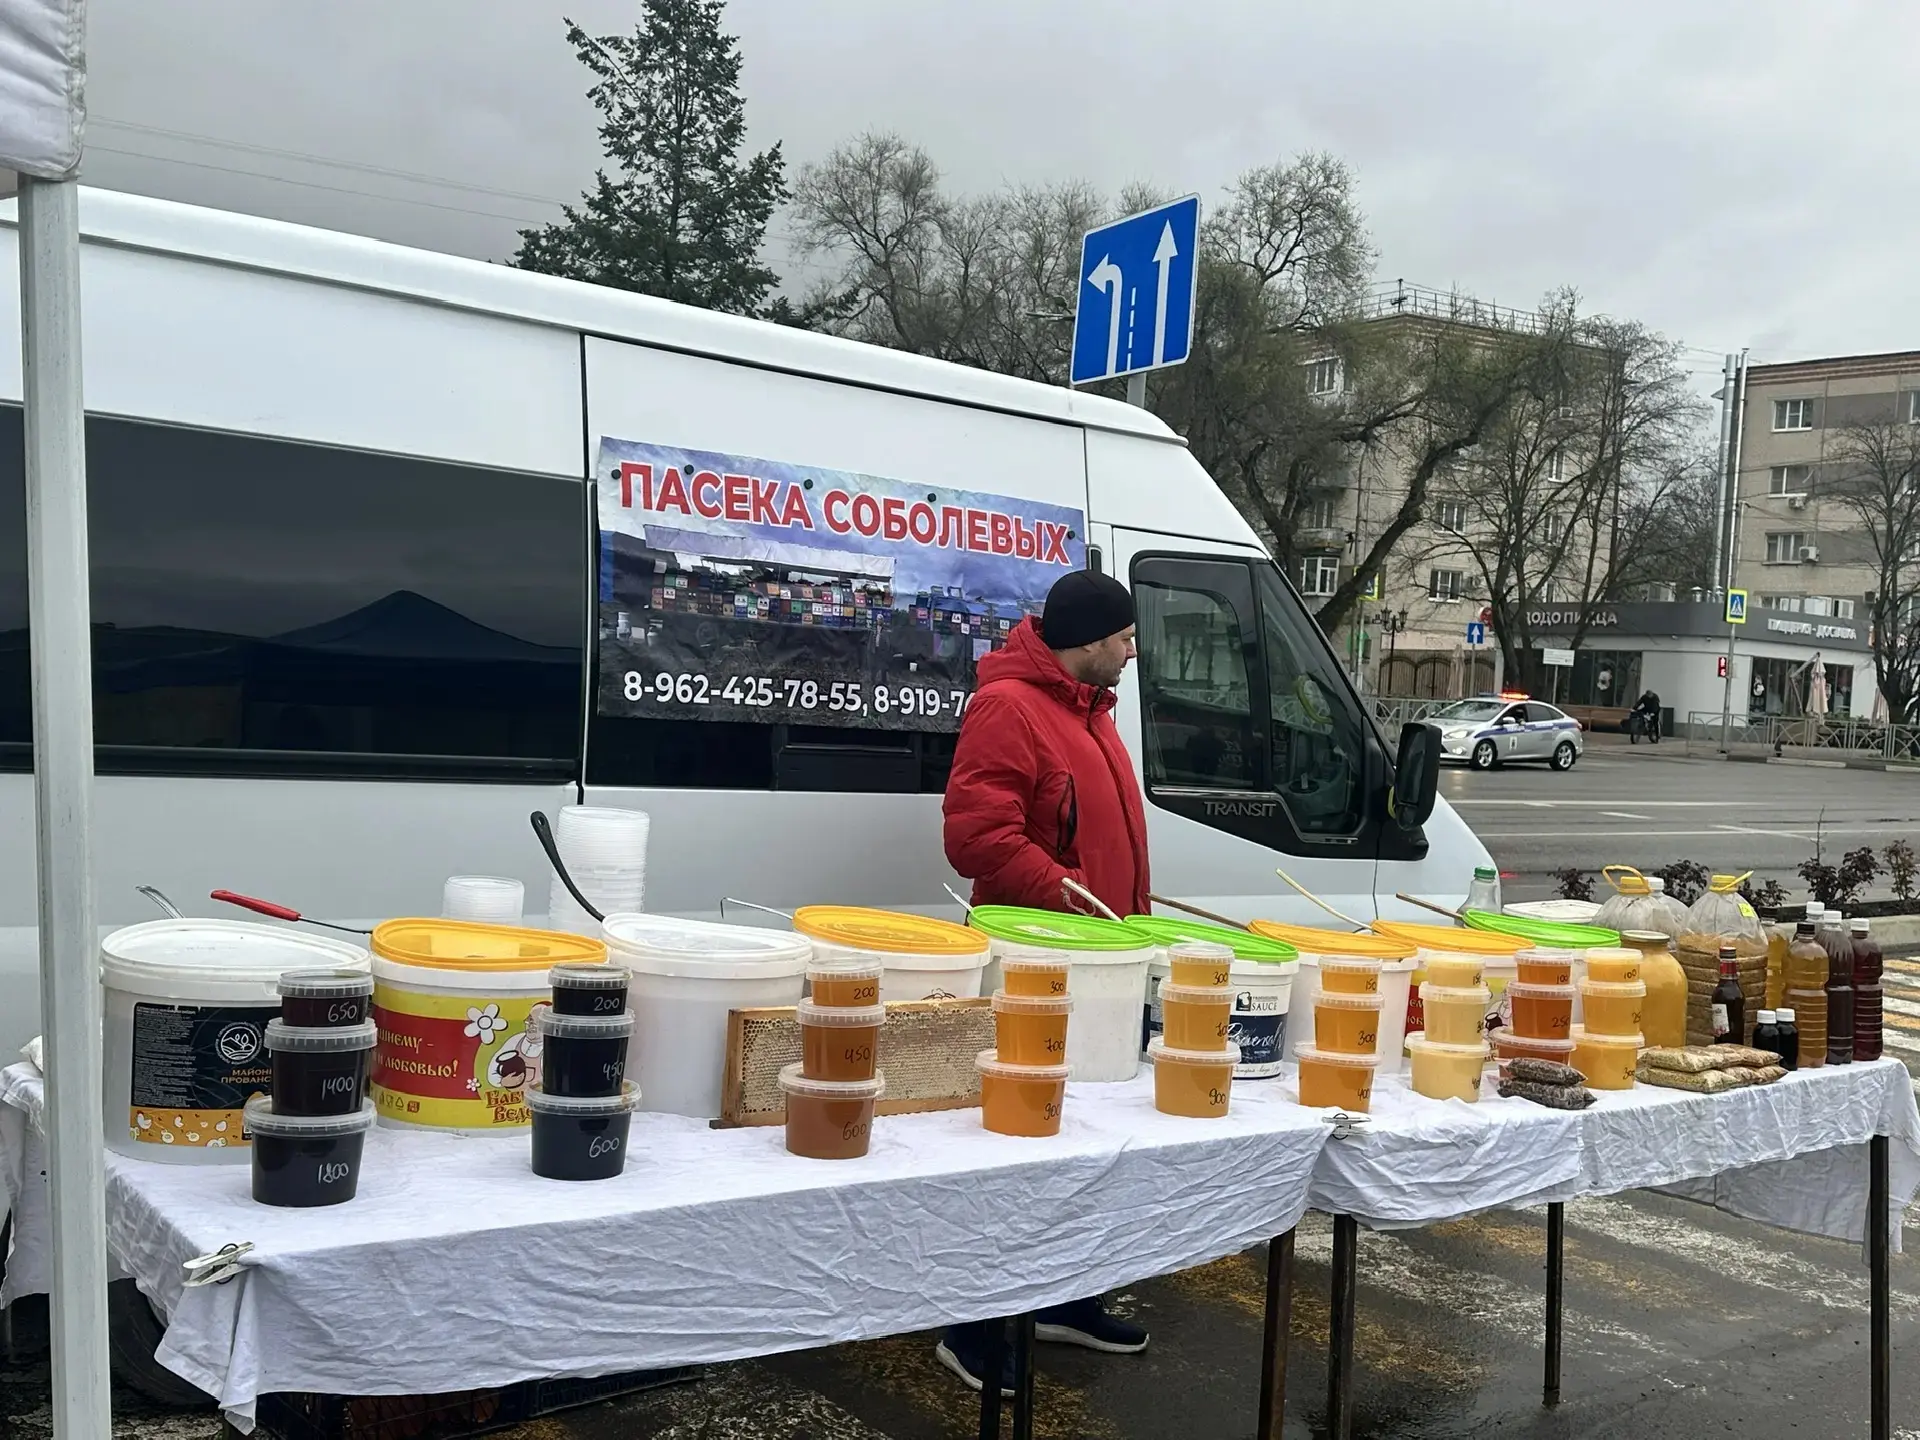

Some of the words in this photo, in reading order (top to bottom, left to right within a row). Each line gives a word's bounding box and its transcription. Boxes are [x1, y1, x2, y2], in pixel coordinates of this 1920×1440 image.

[619, 461, 814, 530] ПАСЕКА
[822, 489, 1072, 566] СОБОЛЕВЫХ
[623, 671, 867, 717] 8-962-425-78-55,
[1204, 801, 1276, 817] TRANSIT
[1212, 971, 1229, 985] 300
[1556, 974, 1569, 985] 100
[1623, 968, 1637, 980] 100
[853, 986, 875, 1000] 200
[1049, 980, 1065, 994] 300
[327, 1003, 357, 1021] 650
[593, 997, 620, 1012] 200
[1251, 1002, 1277, 1011] SAUCE
[1631, 1011, 1641, 1024] 25
[1358, 1031, 1375, 1046] 300
[844, 1047, 871, 1065] 450
[232, 1067, 272, 1076] МАЙОН
[602, 1061, 623, 1080] 450
[220, 1076, 272, 1084] ПРОВАНС
[322, 1076, 355, 1099] 1400
[1209, 1088, 1226, 1106] 900
[1357, 1088, 1371, 1101] 400
[842, 1121, 867, 1141] 600
[588, 1136, 620, 1158] 600
[317, 1161, 349, 1184] 1800
